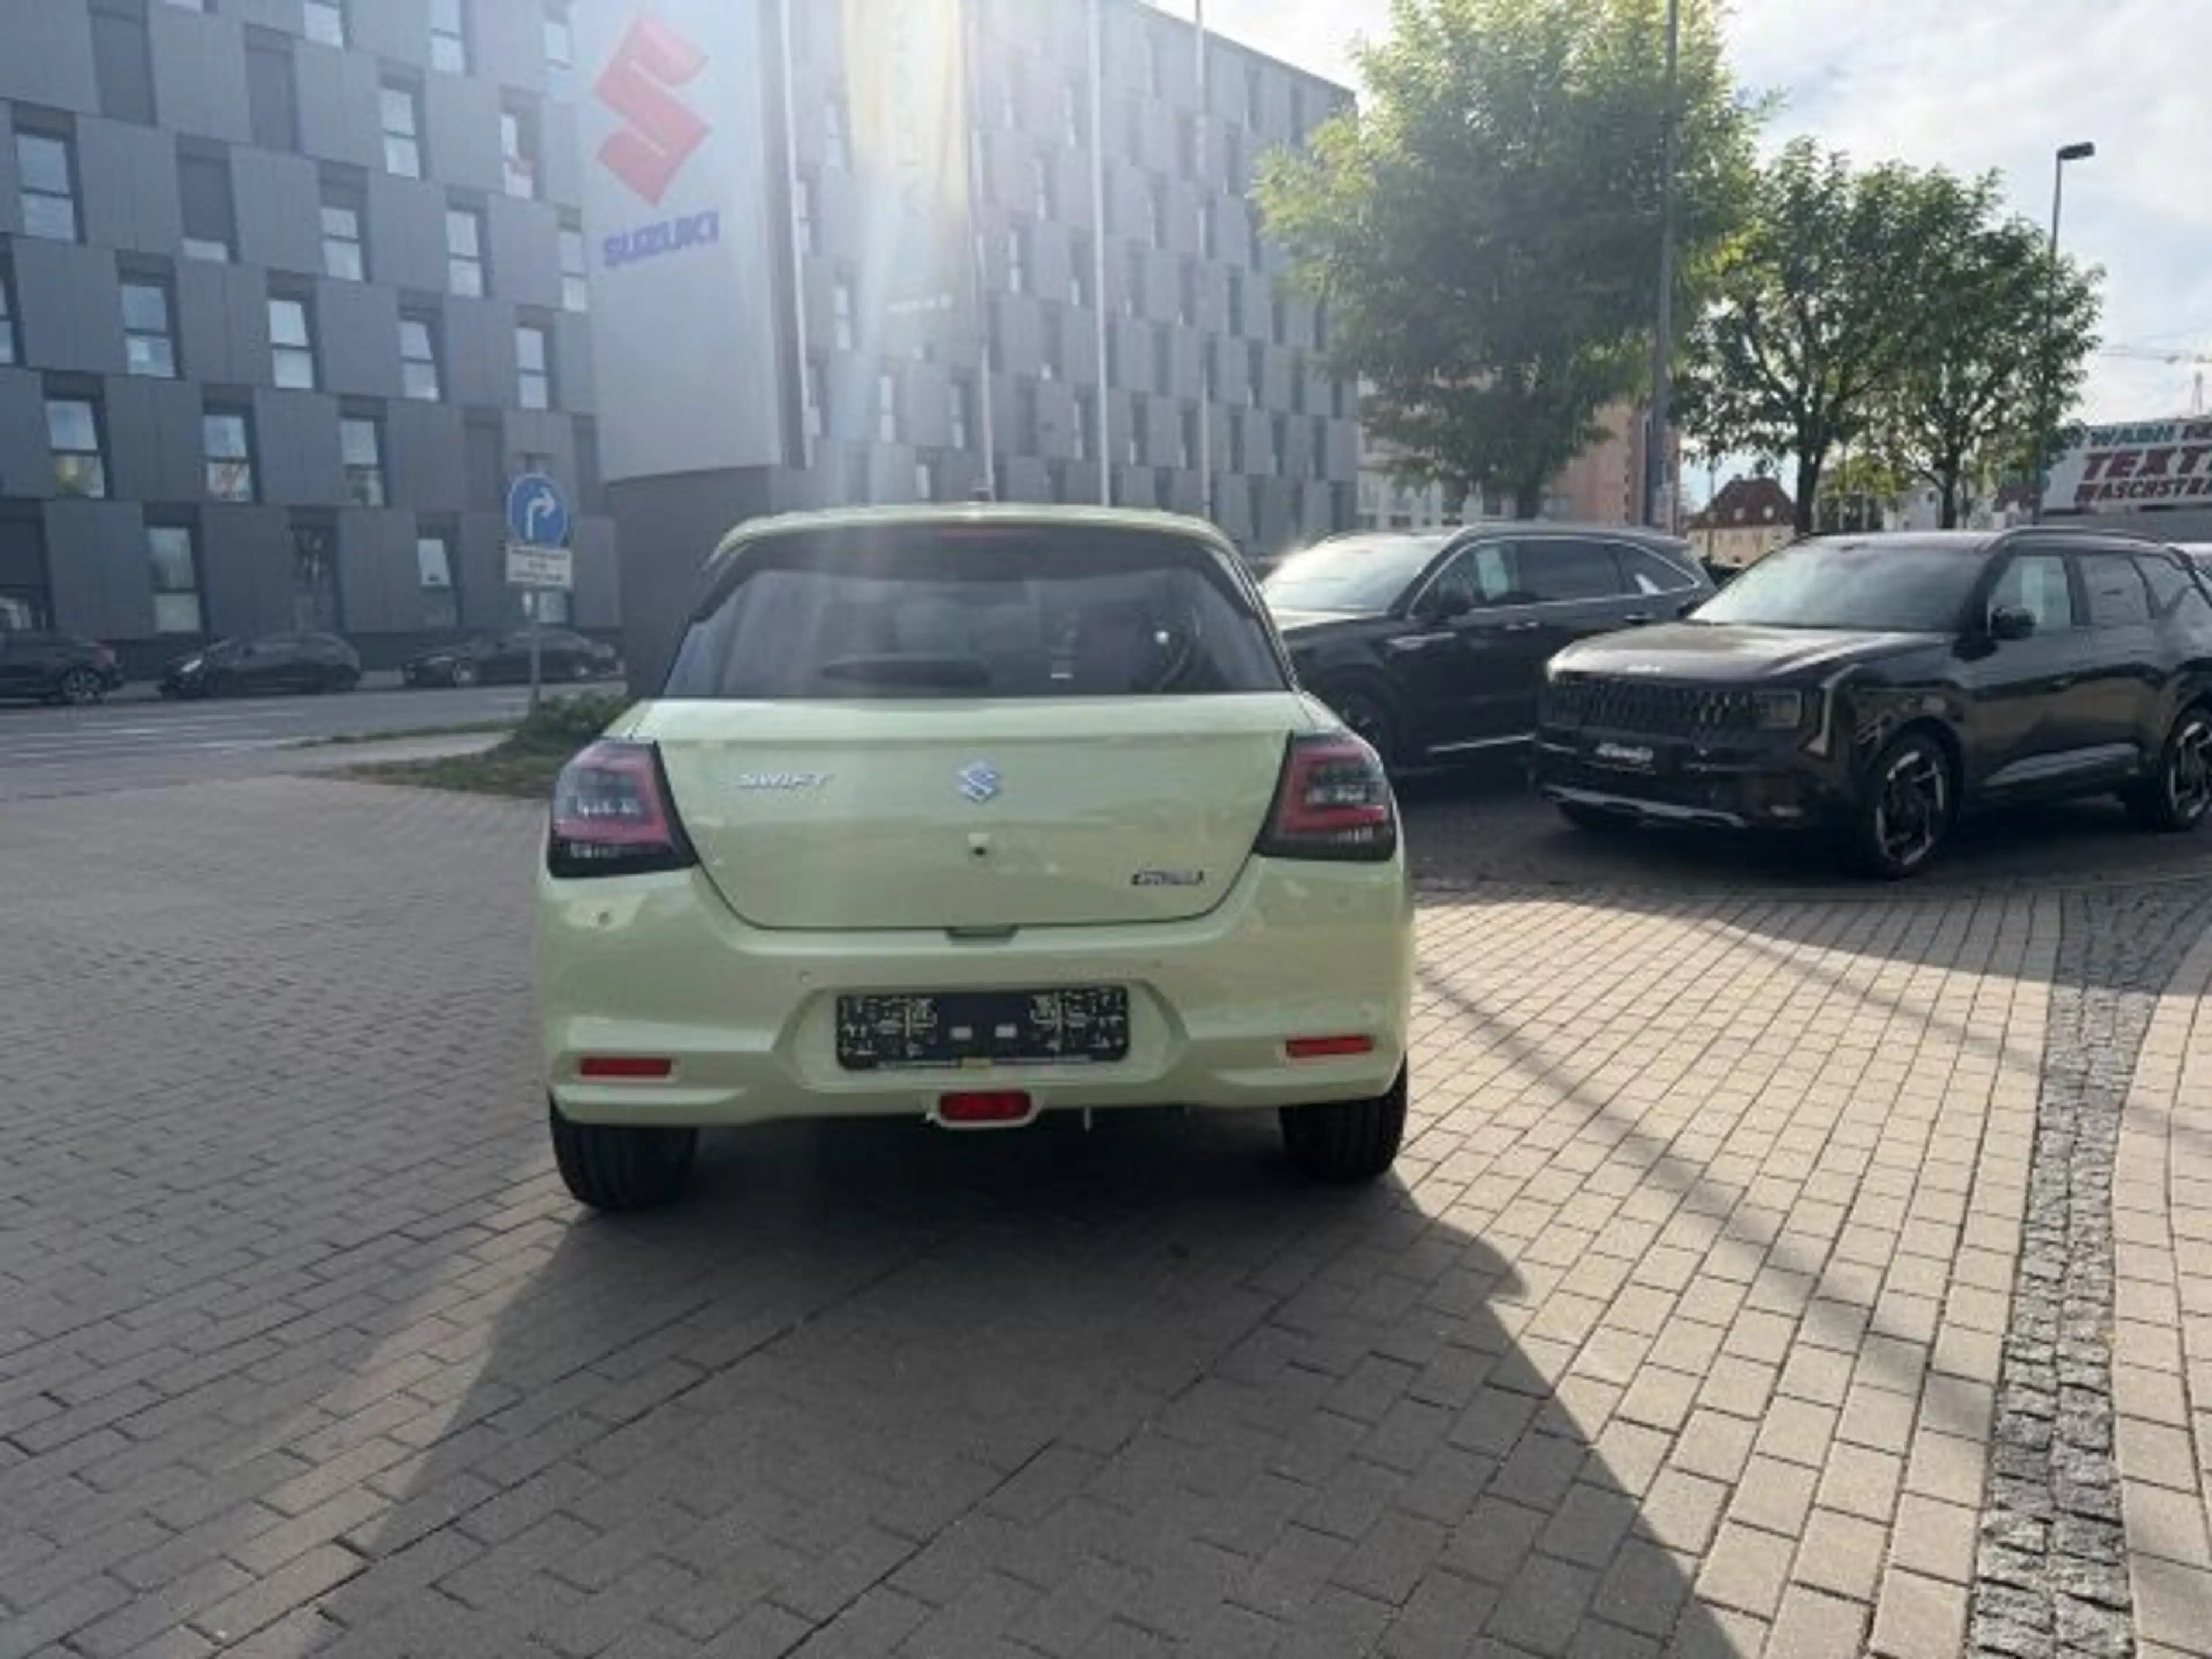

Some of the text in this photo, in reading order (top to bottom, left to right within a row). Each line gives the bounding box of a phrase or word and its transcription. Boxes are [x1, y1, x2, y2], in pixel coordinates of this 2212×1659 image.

[604, 211, 719, 267] SUZUKI
[2082, 446, 2212, 480] TEXT
[738, 772, 835, 789] SWIFT
